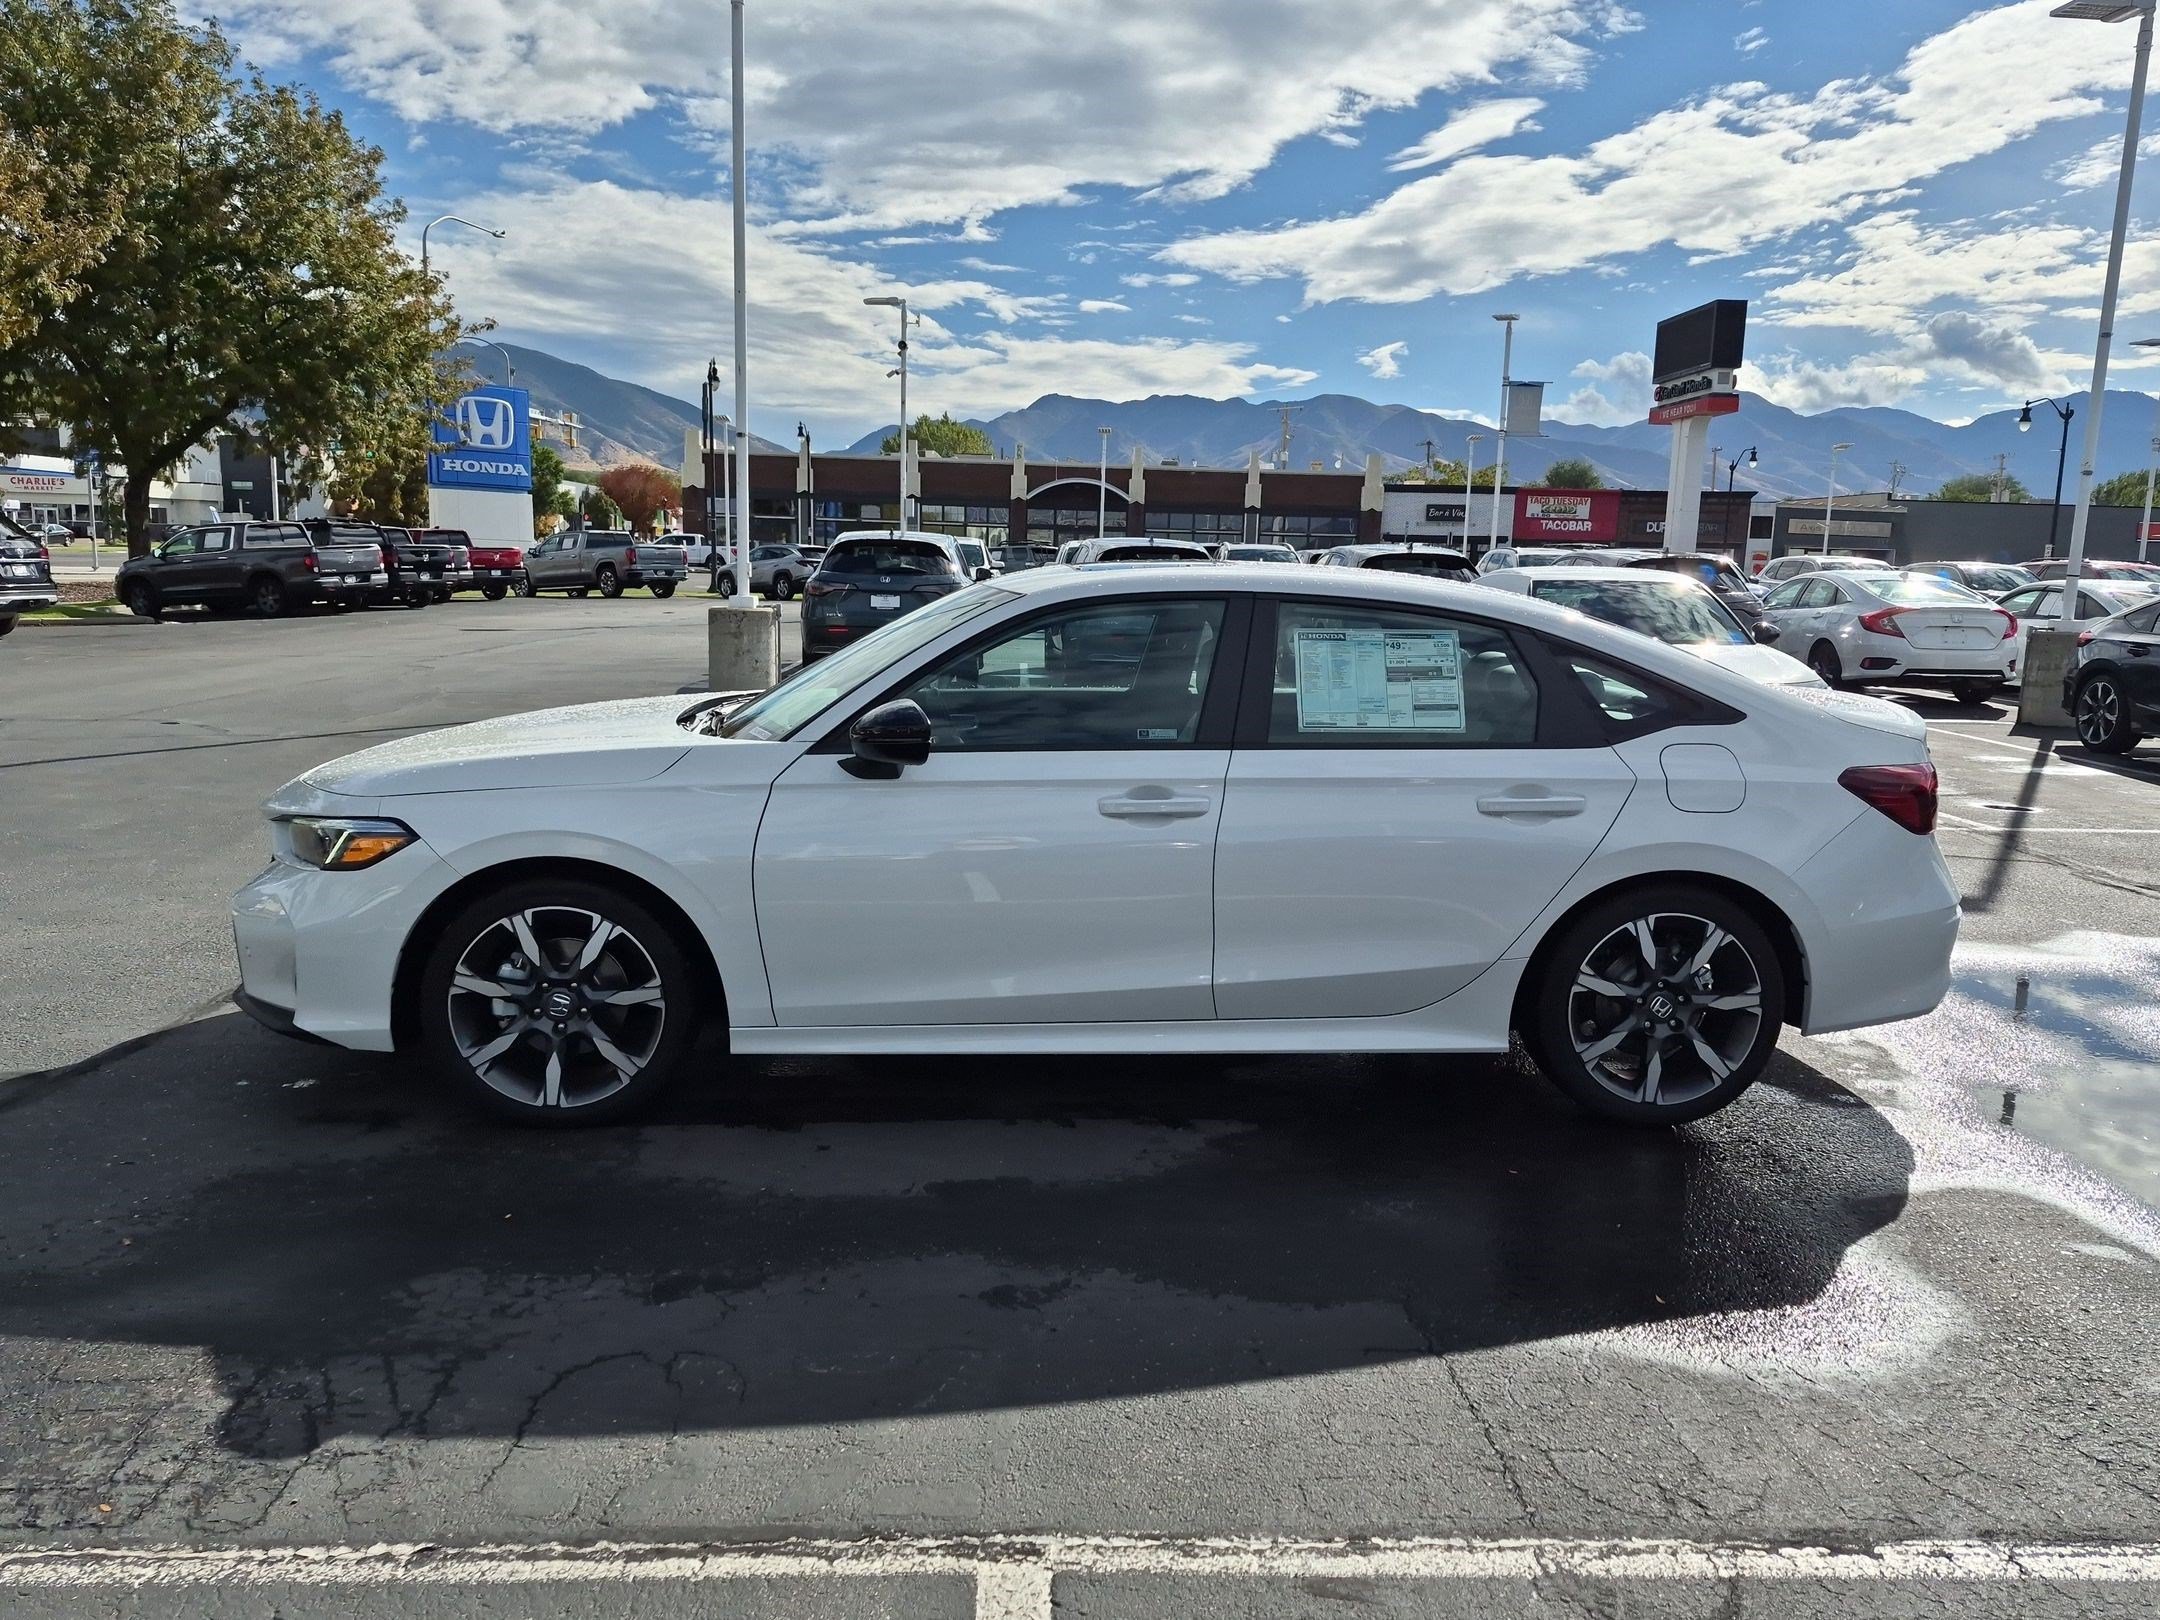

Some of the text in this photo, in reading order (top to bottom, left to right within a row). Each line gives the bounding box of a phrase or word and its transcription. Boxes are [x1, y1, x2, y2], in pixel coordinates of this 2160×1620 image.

[442, 458, 529, 476] HONDA
[10, 476, 65, 486] CHARLIE'S
[1529, 496, 1589, 506] TACO TUESDAY
[1428, 508, 1444, 517] Bar
[1540, 520, 1592, 531] TACOBAR
[1389, 641, 1401, 650] 49
